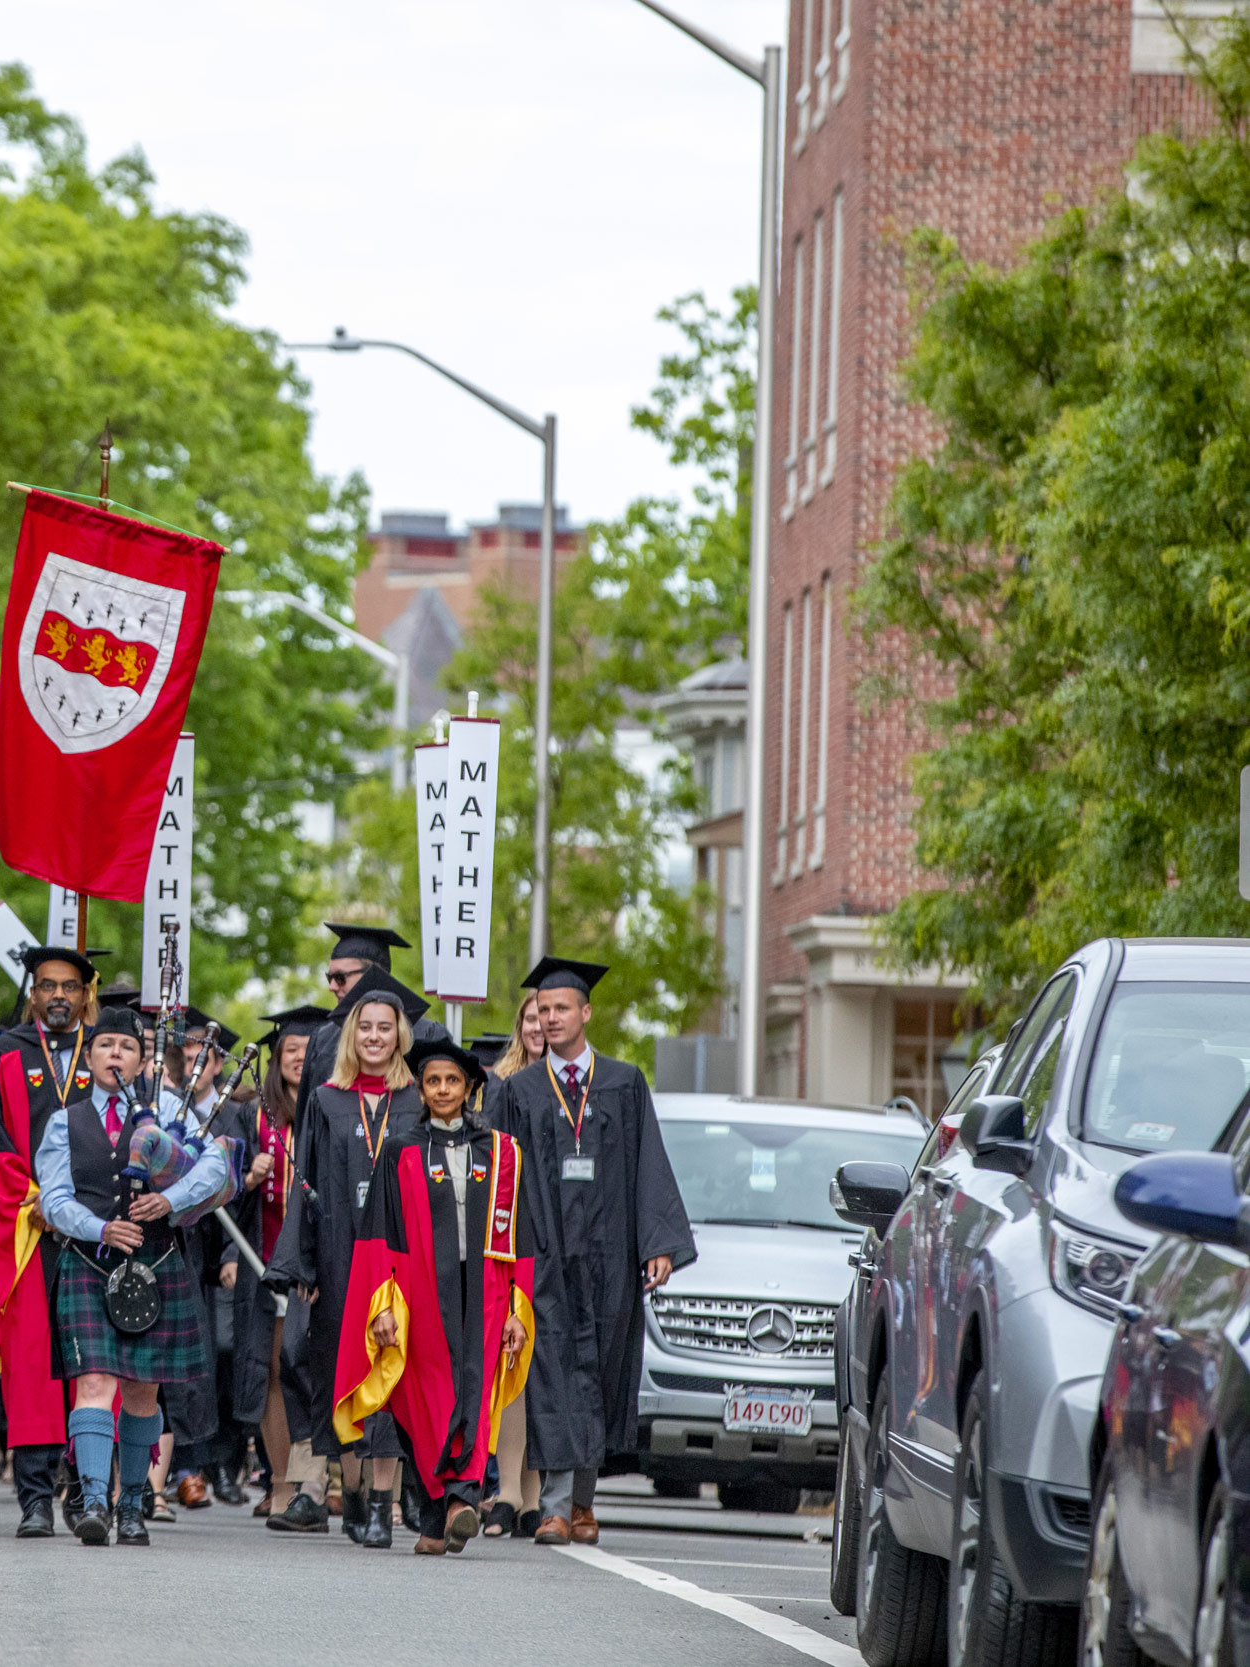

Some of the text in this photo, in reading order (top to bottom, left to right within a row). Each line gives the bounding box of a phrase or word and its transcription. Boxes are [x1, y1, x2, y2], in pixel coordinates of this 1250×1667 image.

[455, 760, 487, 958] MATHER
[731, 1401, 803, 1425] 149 C90
